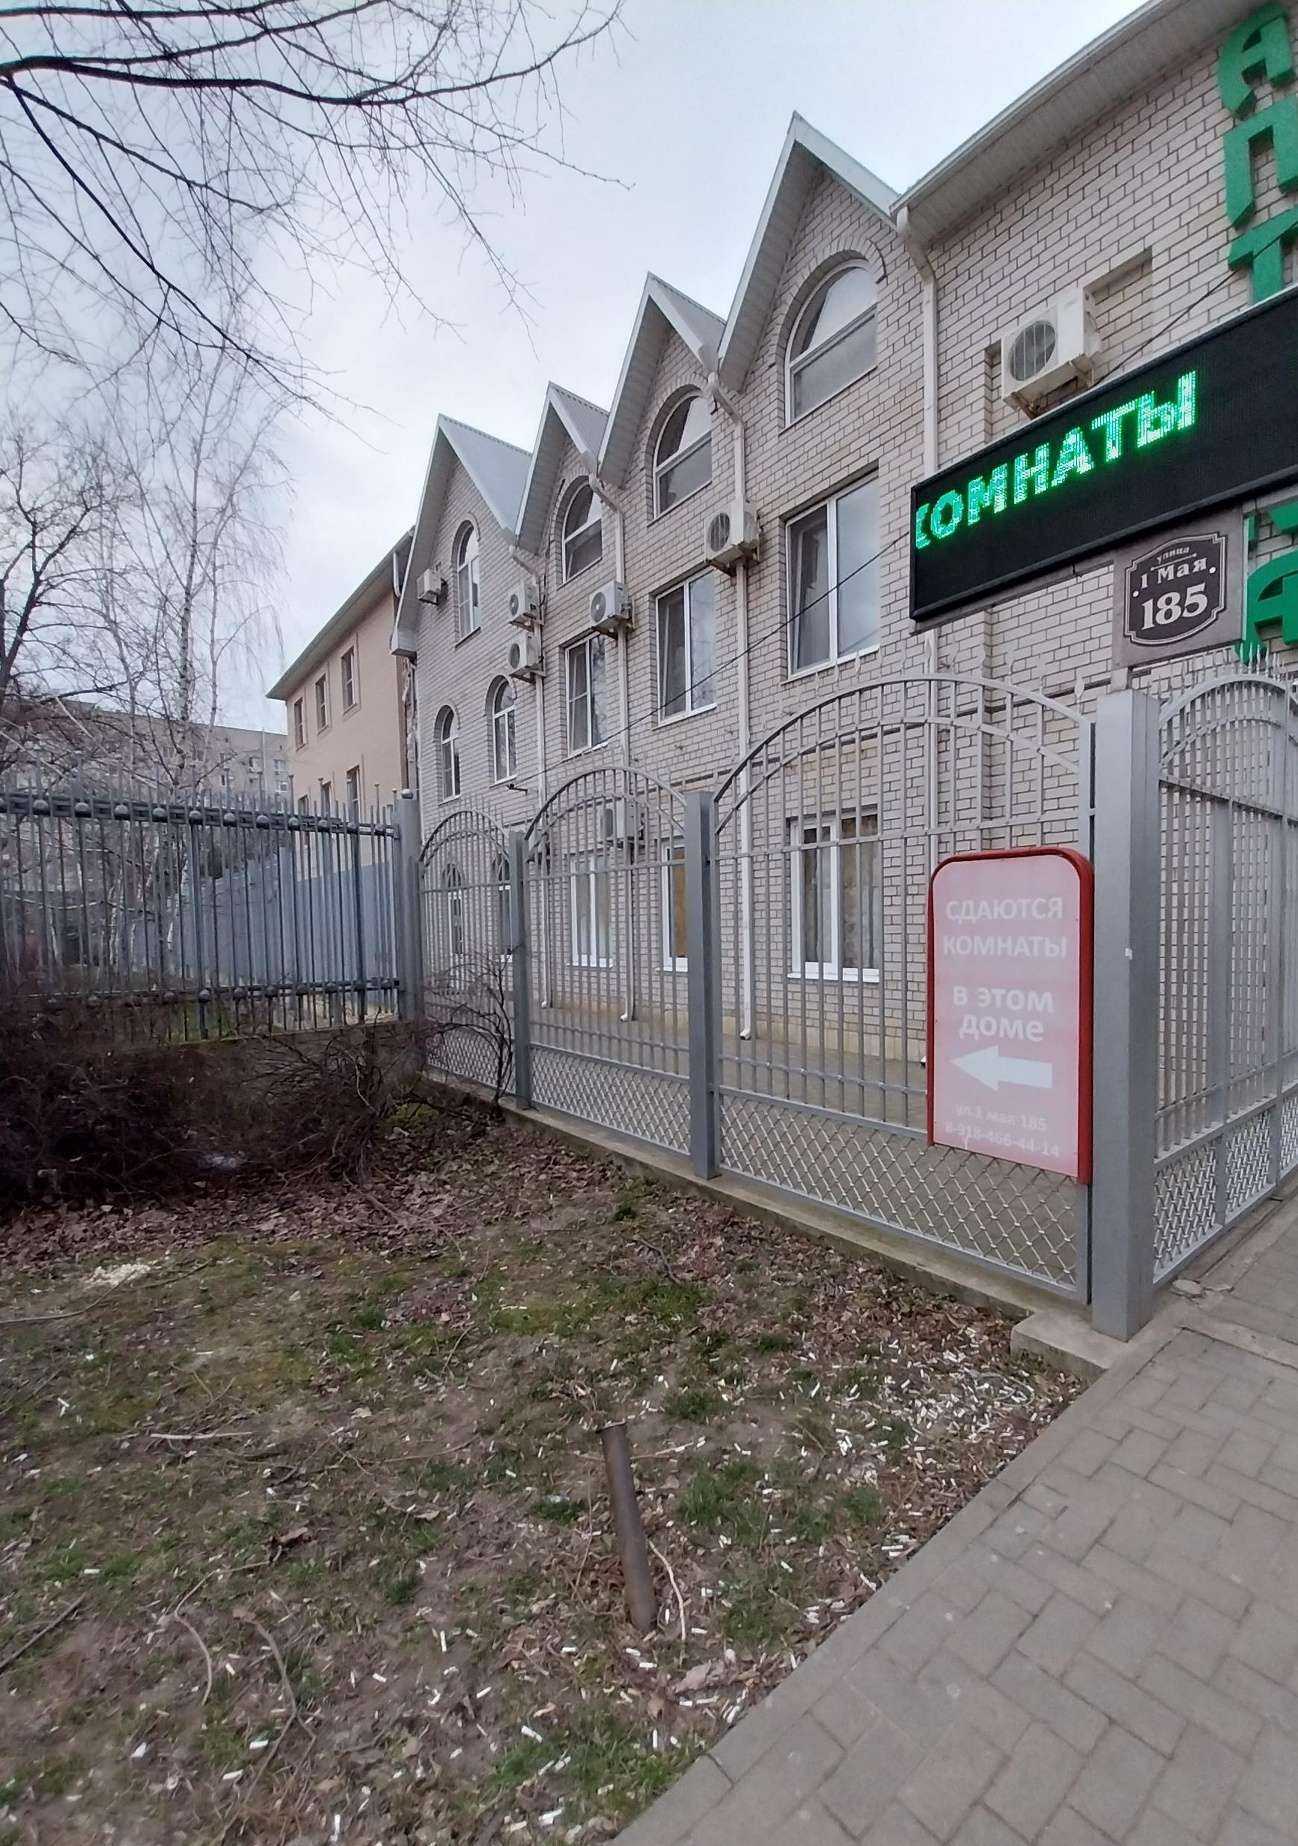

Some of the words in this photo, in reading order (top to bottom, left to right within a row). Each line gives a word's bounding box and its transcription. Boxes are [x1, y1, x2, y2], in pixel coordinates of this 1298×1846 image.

[1156, 546, 1190, 564] улица
[1140, 573, 1149, 589] 1
[1157, 557, 1208, 584] Мая
[1141, 582, 1208, 630] 185
[945, 896, 1064, 926] СДАЮТСЯ
[943, 935, 1067, 959] КОМНАТЫ
